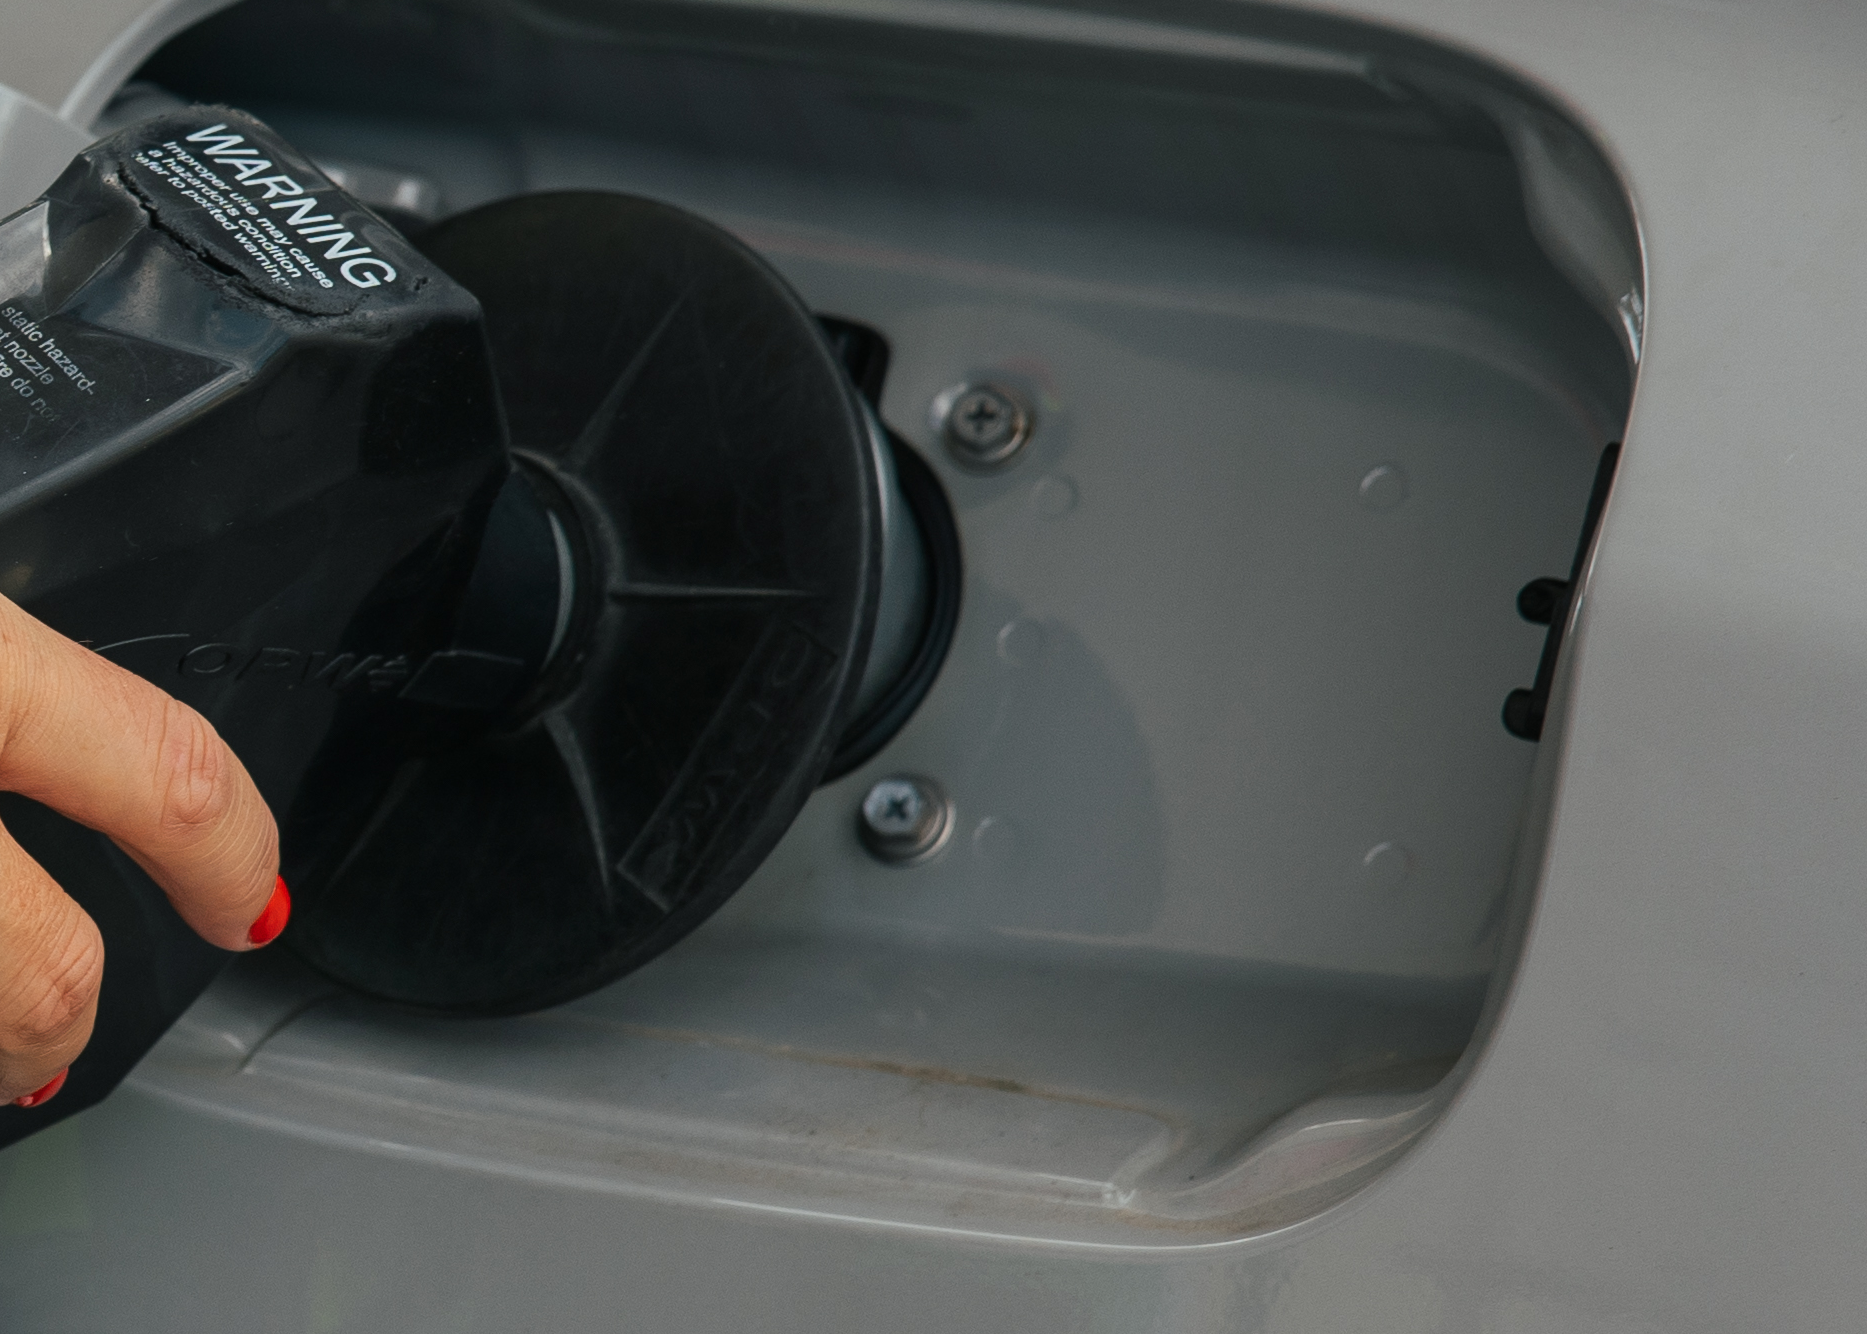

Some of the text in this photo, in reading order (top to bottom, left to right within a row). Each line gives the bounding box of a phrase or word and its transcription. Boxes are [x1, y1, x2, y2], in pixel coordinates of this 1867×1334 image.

[147, 149, 303, 279] a hazardous condition
[163, 141, 334, 289] Improper use may cause
[167, 176, 185, 189] to
[180, 189, 239, 231] posted
[185, 123, 397, 289] WARNING
[1, 306, 96, 395] static hazard-
[4, 340, 54, 385] nozzle
[10, 377, 35, 398] do
